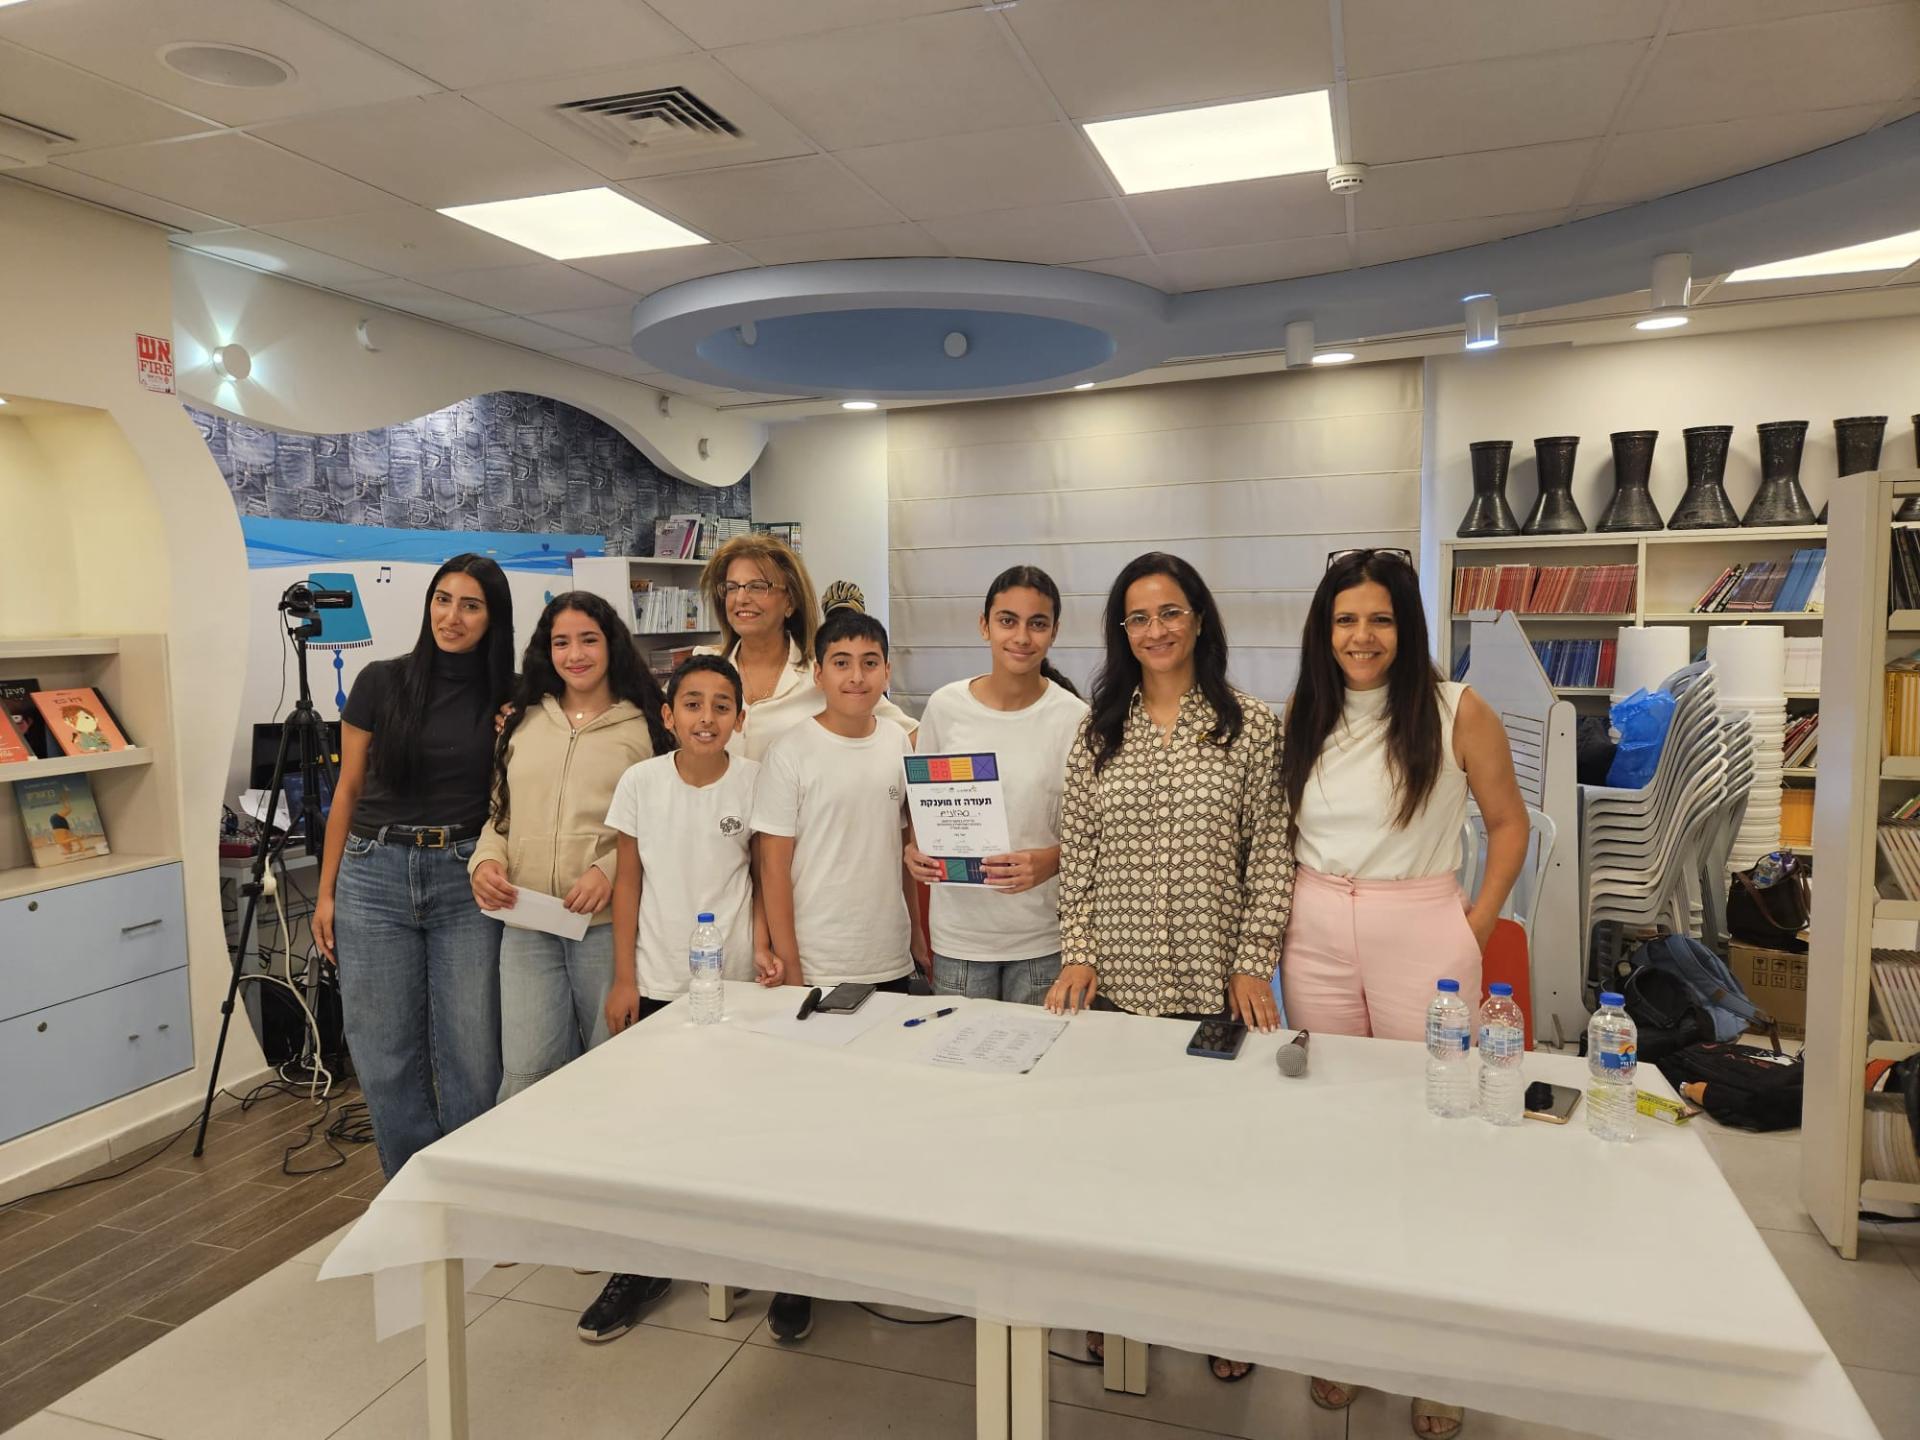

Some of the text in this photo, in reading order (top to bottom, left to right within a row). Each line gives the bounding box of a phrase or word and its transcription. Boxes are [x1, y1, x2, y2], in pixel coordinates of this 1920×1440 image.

[138, 336, 171, 363] אש
[140, 360, 172, 376] FIRE
[920, 798, 992, 807] תעודה זו מוענקת
